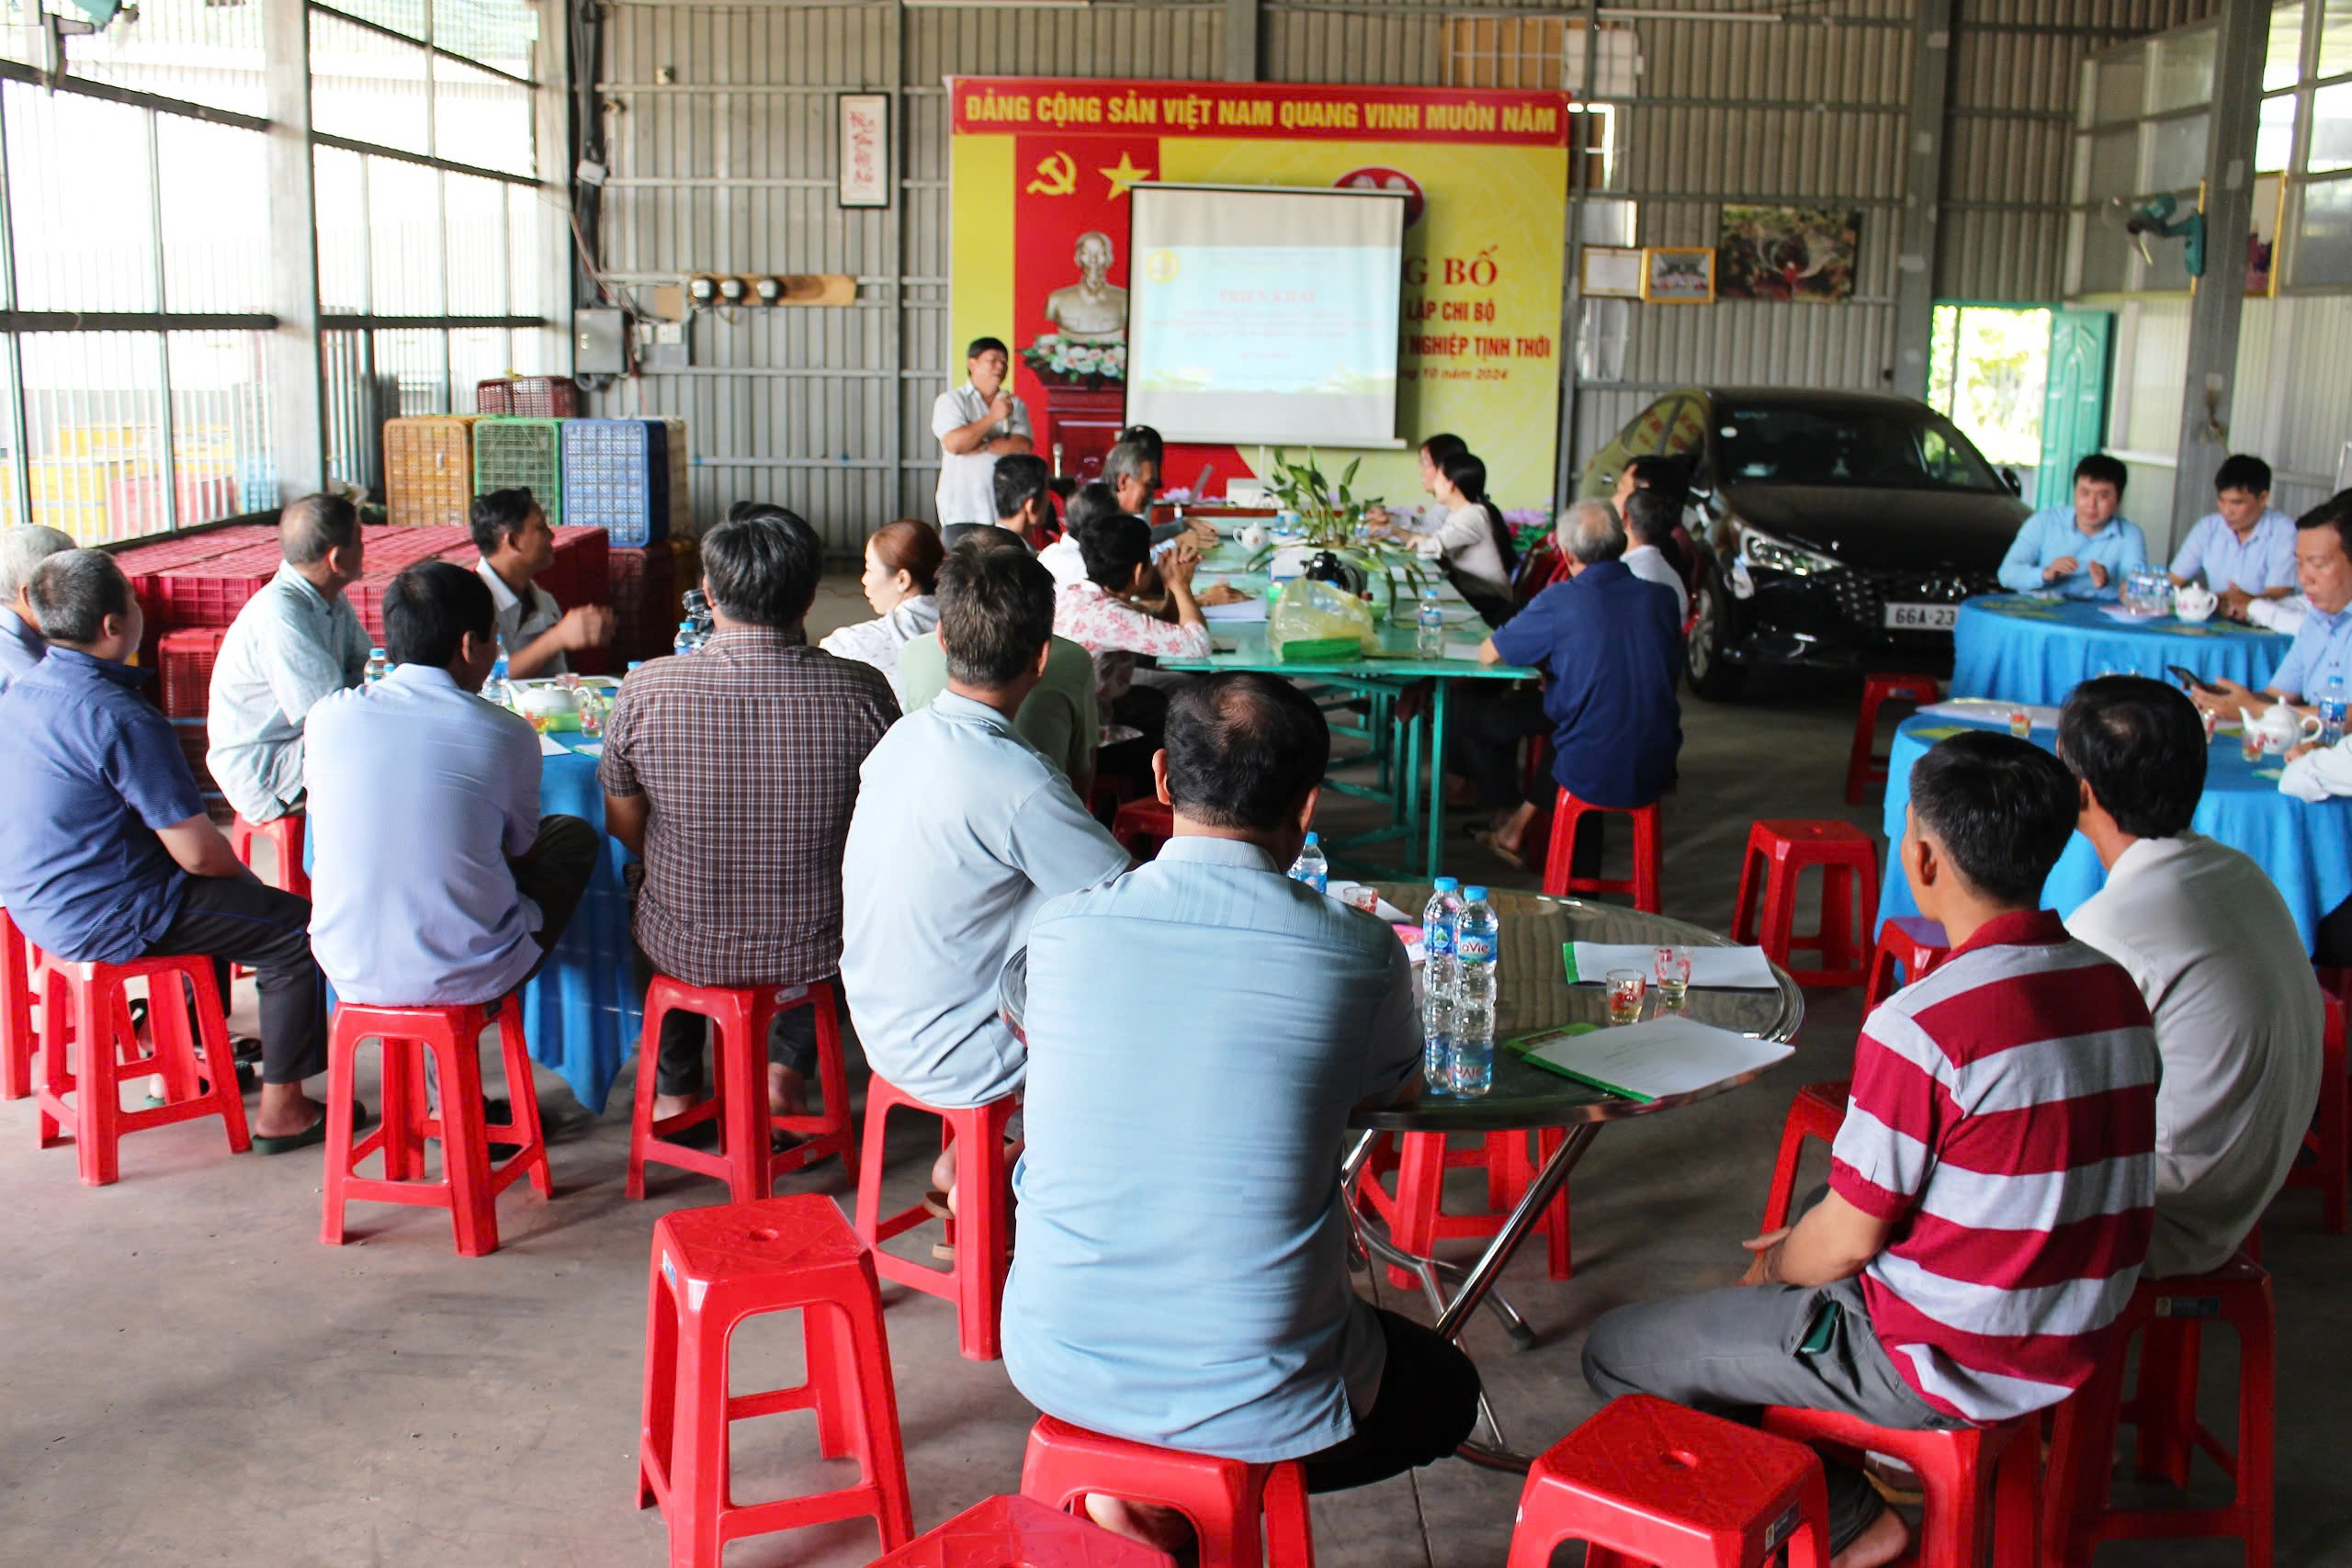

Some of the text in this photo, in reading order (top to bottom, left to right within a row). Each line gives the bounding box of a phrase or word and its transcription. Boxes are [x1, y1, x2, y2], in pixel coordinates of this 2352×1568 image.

[965, 89, 1556, 132] ĐẢNG CỘNG SẢN VIỆT NAM QUANG VINH MUÔN NĂM
[1443, 244, 1498, 287] BỐ
[1442, 301, 1468, 321] CHI
[1474, 299, 1496, 326] BỘ
[1410, 333, 1468, 360] NGHIỆP
[1474, 335, 1510, 361] TỊNH
